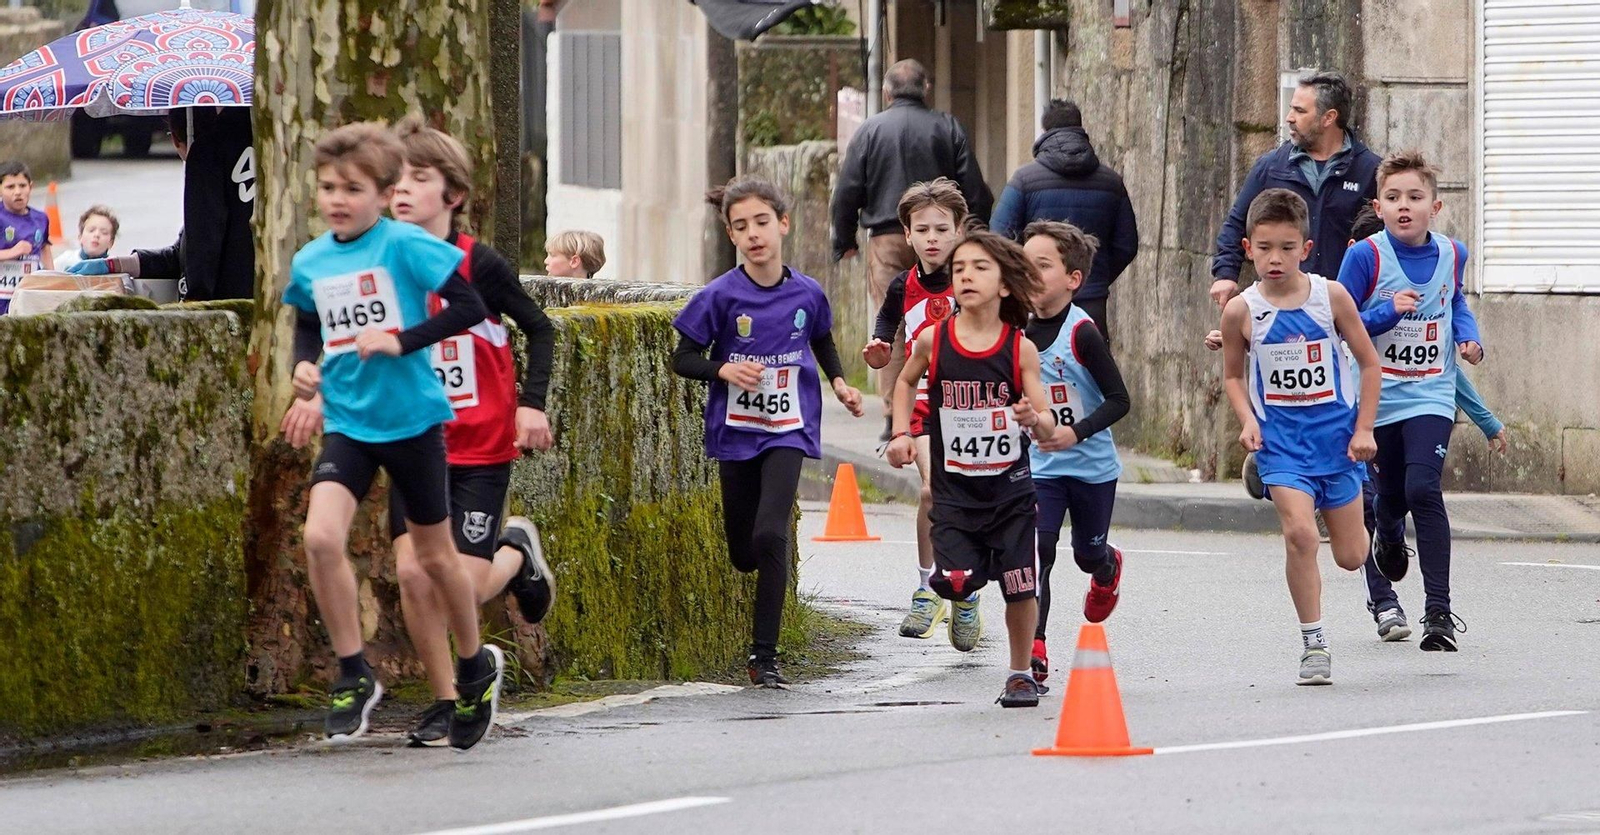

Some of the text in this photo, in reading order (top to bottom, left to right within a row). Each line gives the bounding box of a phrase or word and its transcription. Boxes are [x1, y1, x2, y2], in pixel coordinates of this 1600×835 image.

[325, 300, 386, 331] 4469
[1270, 349, 1303, 357] CONCELLO
[1384, 343, 1439, 365] 4499
[1269, 365, 1326, 390] 4503
[736, 390, 790, 415] 4456
[941, 379, 1011, 411] BULLS
[950, 434, 1011, 457] 4476
